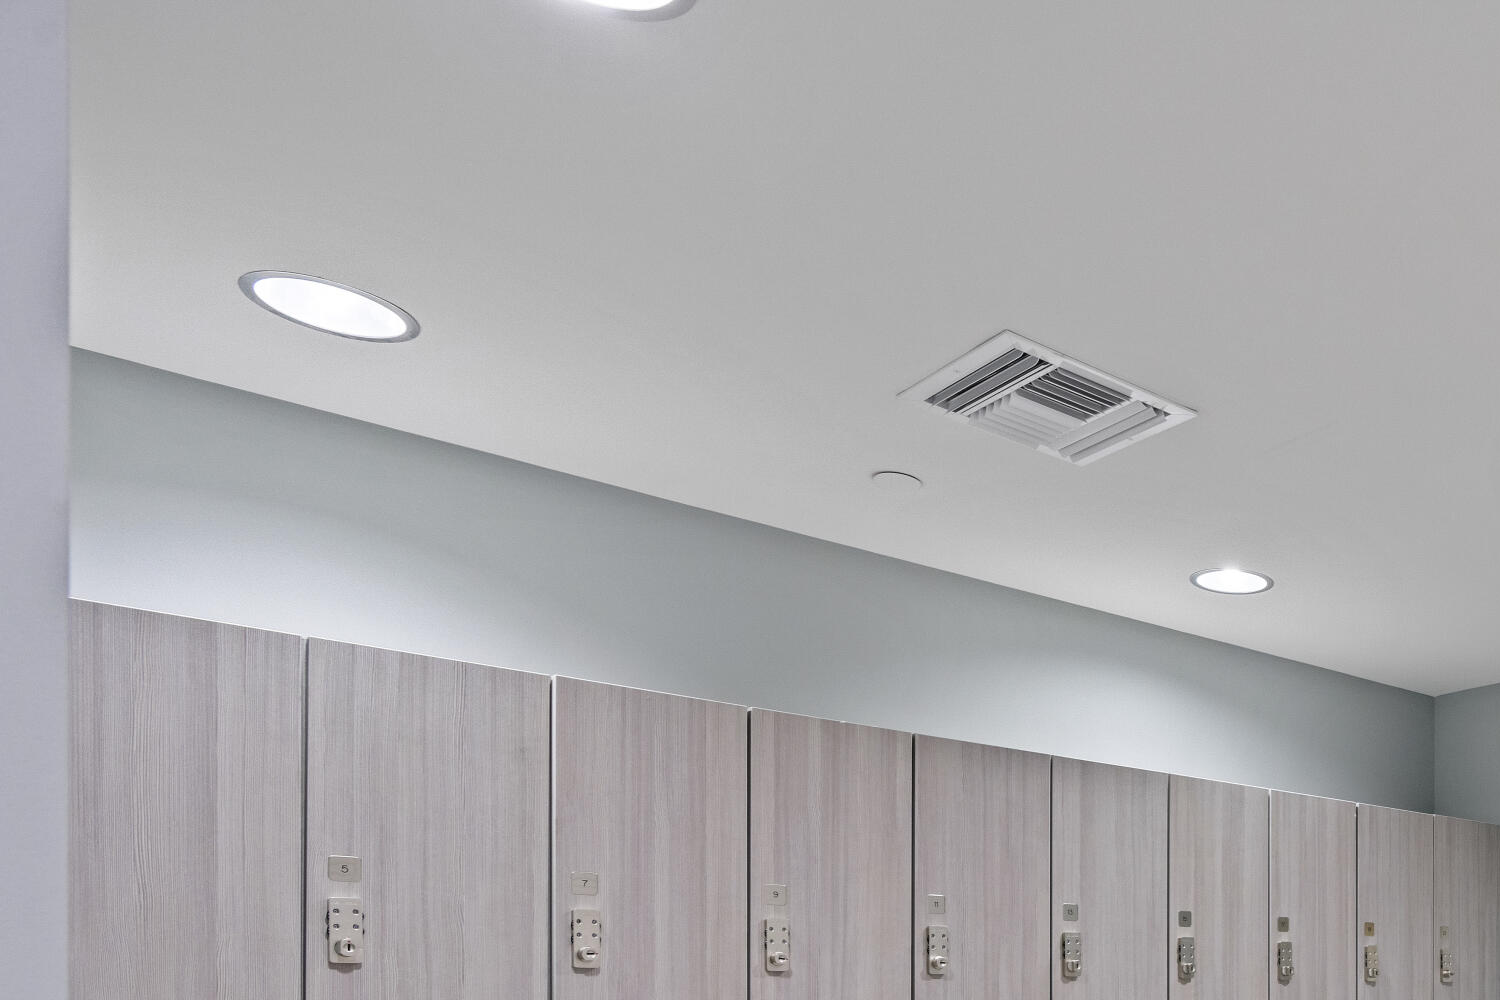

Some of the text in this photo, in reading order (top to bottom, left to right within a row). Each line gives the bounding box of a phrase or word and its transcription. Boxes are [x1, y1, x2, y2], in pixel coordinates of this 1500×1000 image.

[341, 864, 349, 873] 5
[581, 879, 589, 887] 7
[772, 890, 779, 898] 9
